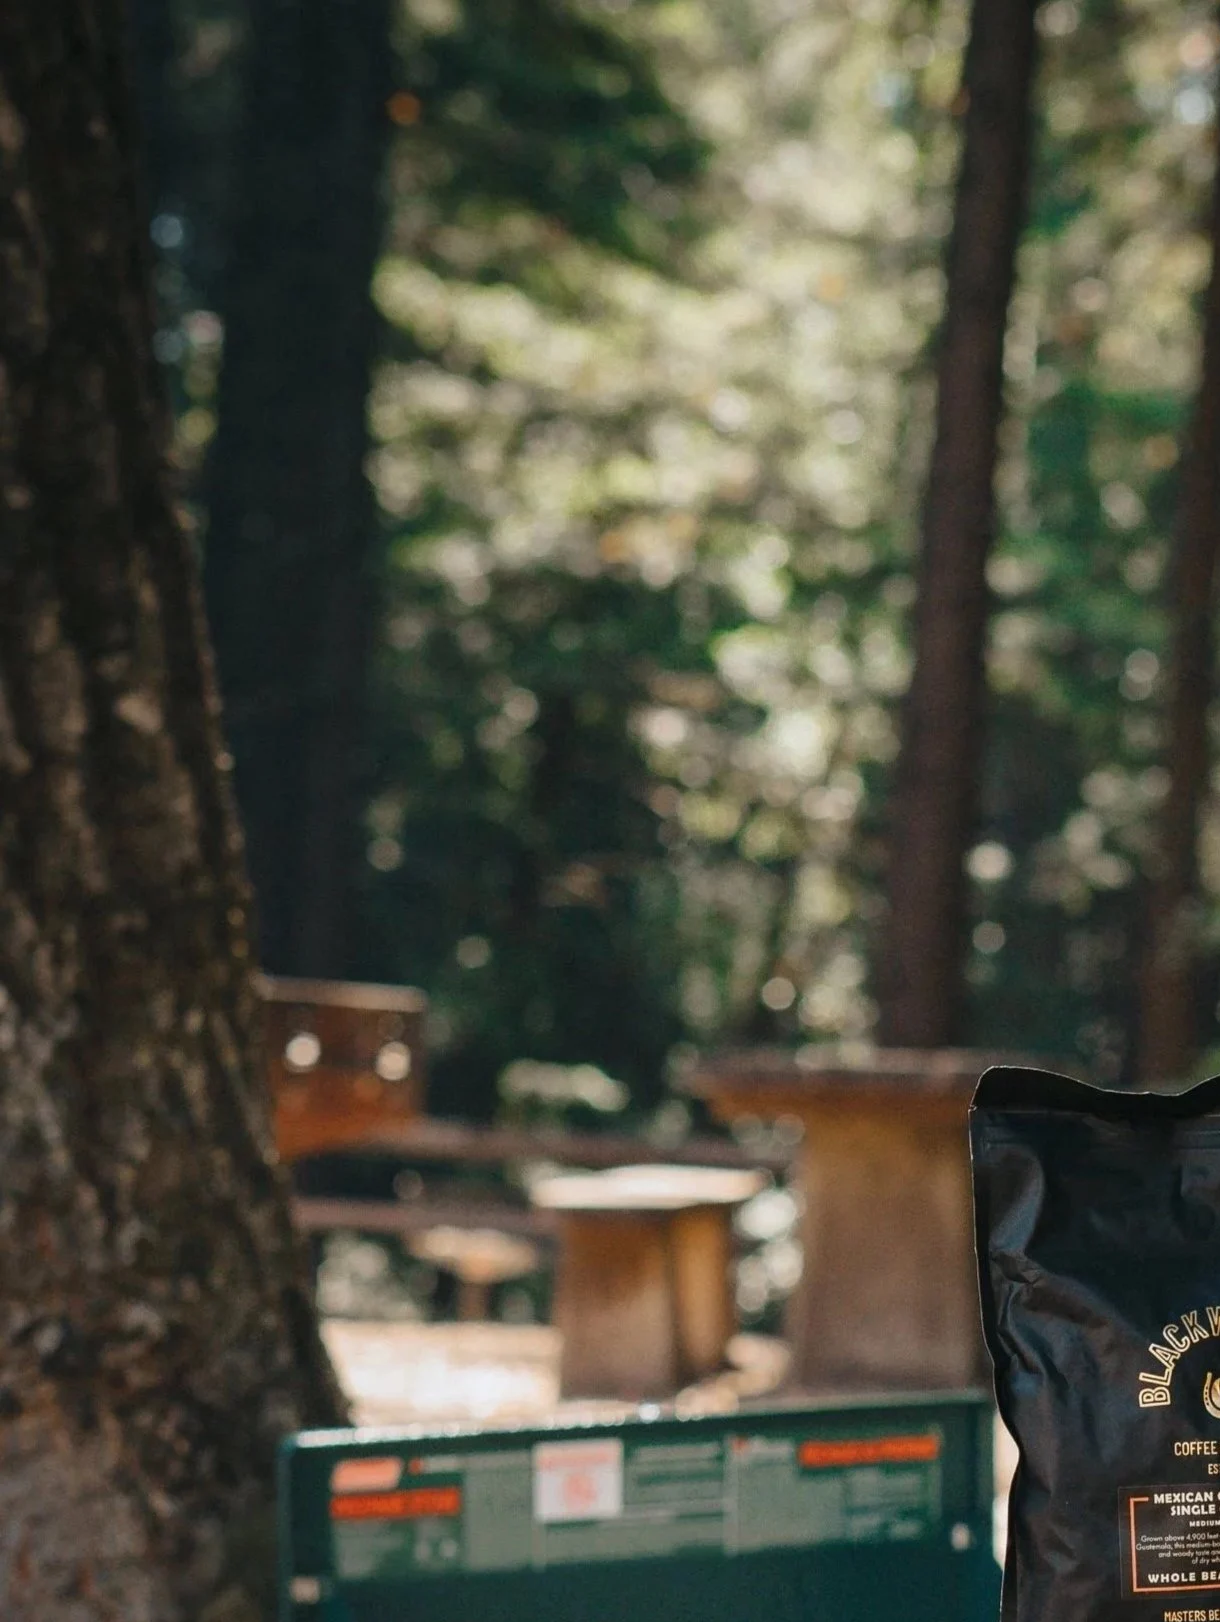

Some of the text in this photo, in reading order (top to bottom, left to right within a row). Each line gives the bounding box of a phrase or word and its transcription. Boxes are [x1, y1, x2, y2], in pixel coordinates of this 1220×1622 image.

[1174, 1441, 1218, 1456] COFFEE
[1153, 1492, 1214, 1504] MEXICAN
[1170, 1503, 1216, 1516] SINGLE
[1189, 1519, 1220, 1527] MEDIUM
[1164, 1534, 1185, 1542] above
[1186, 1533, 1206, 1541] 4,900
[1207, 1532, 1218, 1540] feet
[1136, 1542, 1173, 1551] Guatemala,
[1174, 1541, 1185, 1549] this
[1158, 1550, 1171, 1558] and
[1172, 1550, 1194, 1558] woody
[1191, 1556, 1198, 1565] of
[1199, 1557, 1210, 1565] dry
[1148, 1572, 1196, 1583] WHOLE
[1164, 1610, 1206, 1622] MASTERS
